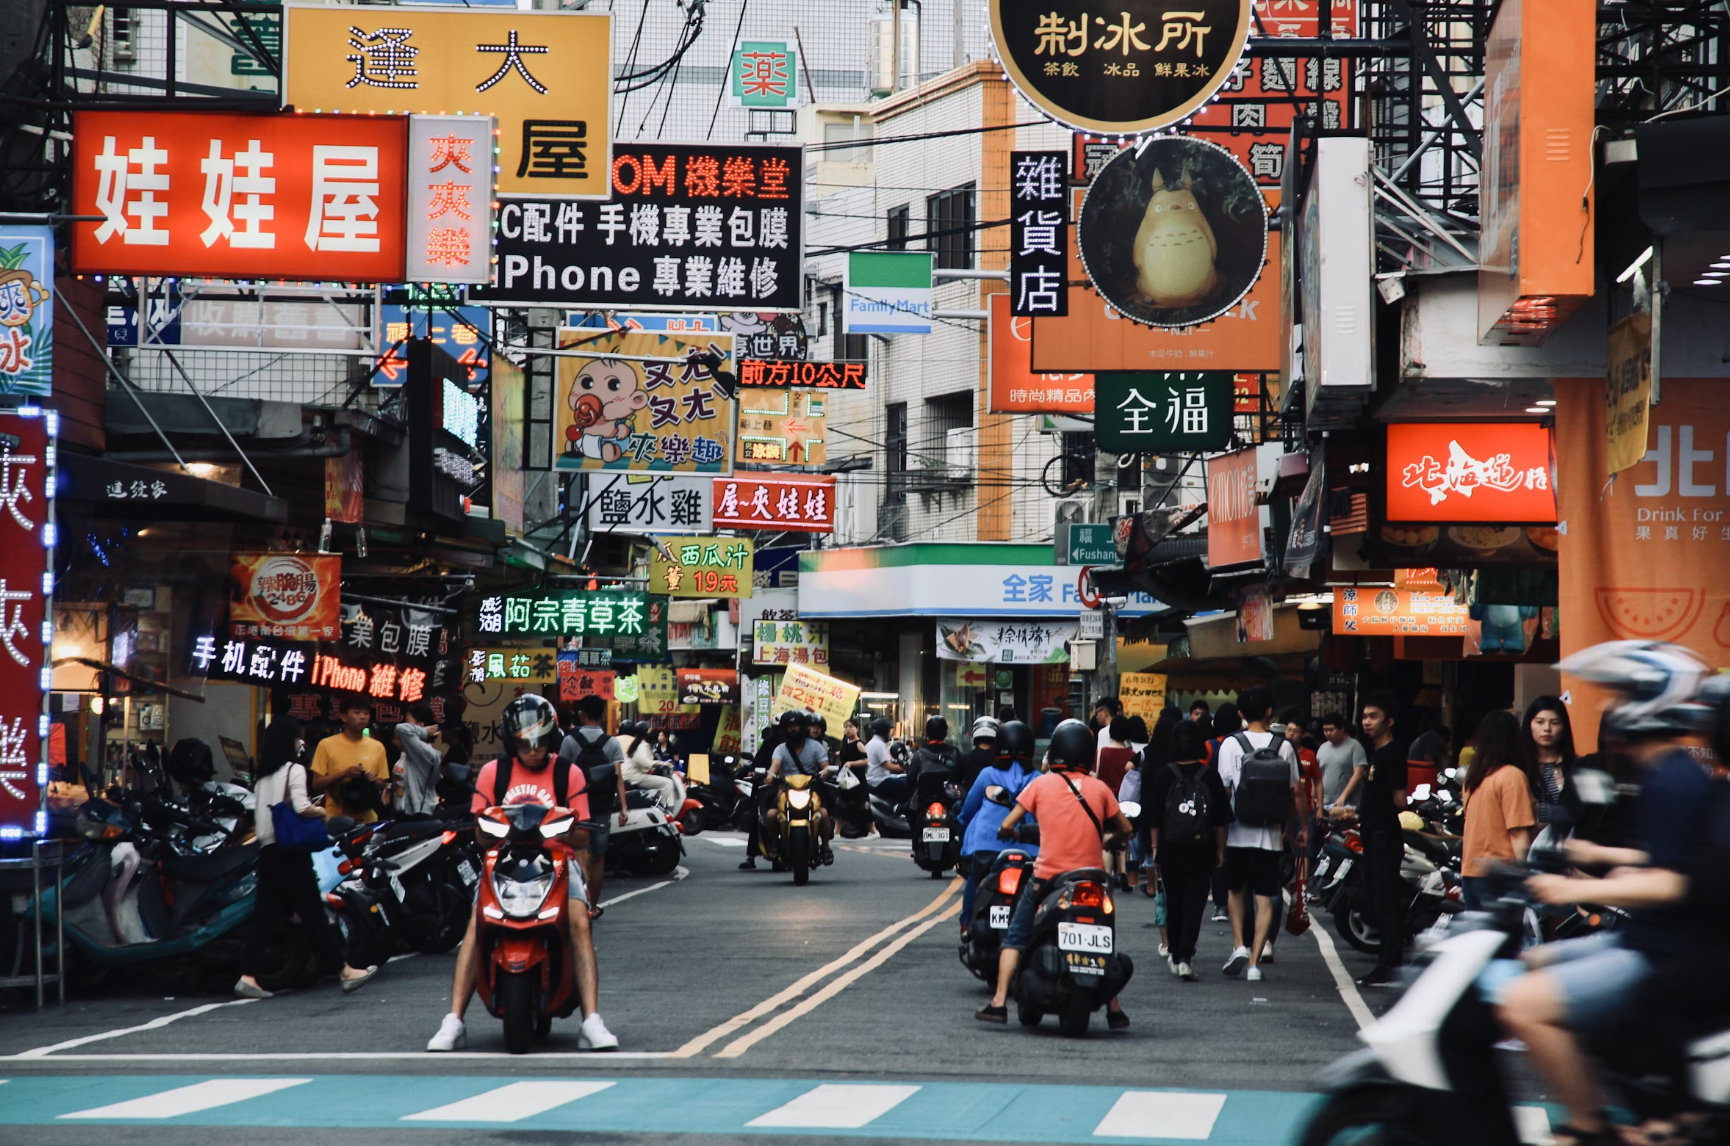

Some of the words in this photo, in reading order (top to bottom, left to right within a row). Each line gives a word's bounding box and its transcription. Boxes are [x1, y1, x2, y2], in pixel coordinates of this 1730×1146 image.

[1044, 62, 1080, 77] 茶飲
[1103, 62, 1140, 77] 冰品
[1154, 62, 1210, 77] 鮮果冰
[516, 120, 589, 180] 屋
[684, 156, 790, 198] 機樂堂
[94, 135, 380, 252] 娃娃屋
[426, 133, 473, 267] 夾夾樂
[597, 203, 789, 249] 手機專業包膜
[1016, 156, 1062, 311] 雜貨店
[652, 254, 779, 298] 專業維修
[850, 299, 930, 316] FamilyMart
[741, 359, 867, 389] 前方10公尺
[628, 432, 725, 464] 夾樂趣
[599, 489, 702, 526] 鹽水雞
[1637, 507, 1685, 522] Drink
[1693, 507, 1723, 522] For
[681, 544, 749, 569] 西瓜汁
[694, 571, 738, 592] 19元
[1002, 574, 1054, 603] 全家
[504, 597, 644, 635] 阿宗青草茶
[757, 622, 828, 645] 楊桃汁
[753, 646, 828, 665] 上海湯包
[311, 653, 366, 692] iPhone
[1060, 931, 1110, 949] 701-JLS
